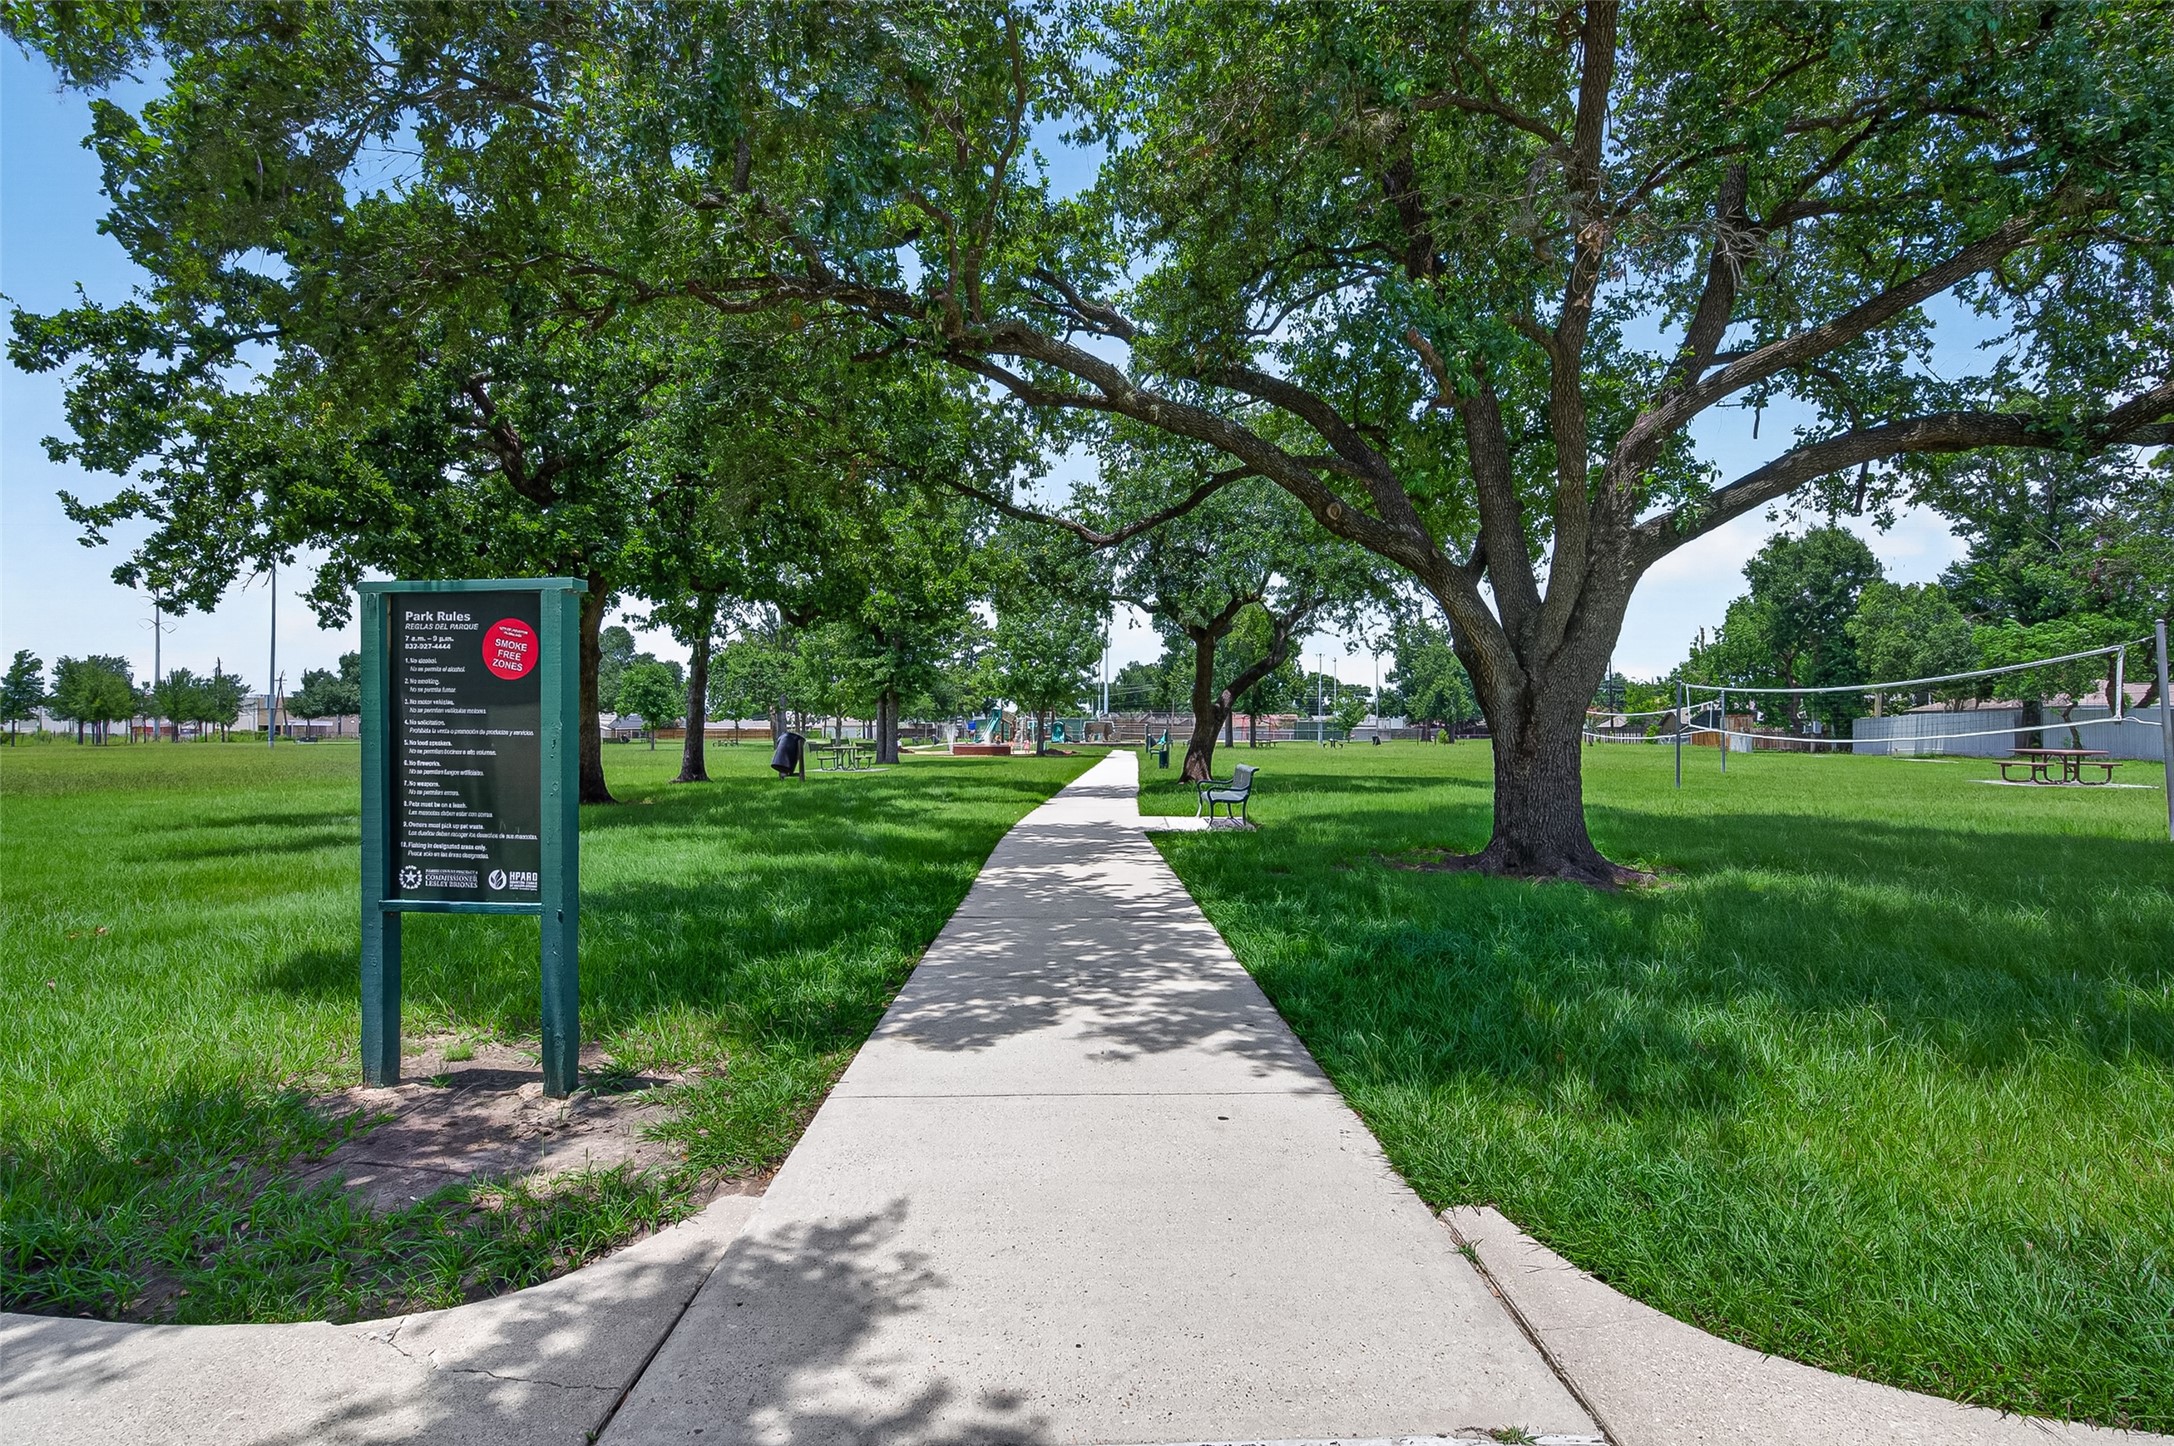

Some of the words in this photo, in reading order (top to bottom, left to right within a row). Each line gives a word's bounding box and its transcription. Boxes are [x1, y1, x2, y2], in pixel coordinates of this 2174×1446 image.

[405, 611, 434, 621] Park
[437, 611, 470, 621] Rules
[450, 623, 479, 631] PARQUE
[495, 638, 528, 652] SMOKE
[498, 650, 521, 661] FREE
[492, 658, 522, 671] ZONES
[509, 872, 538, 881] HPARD
